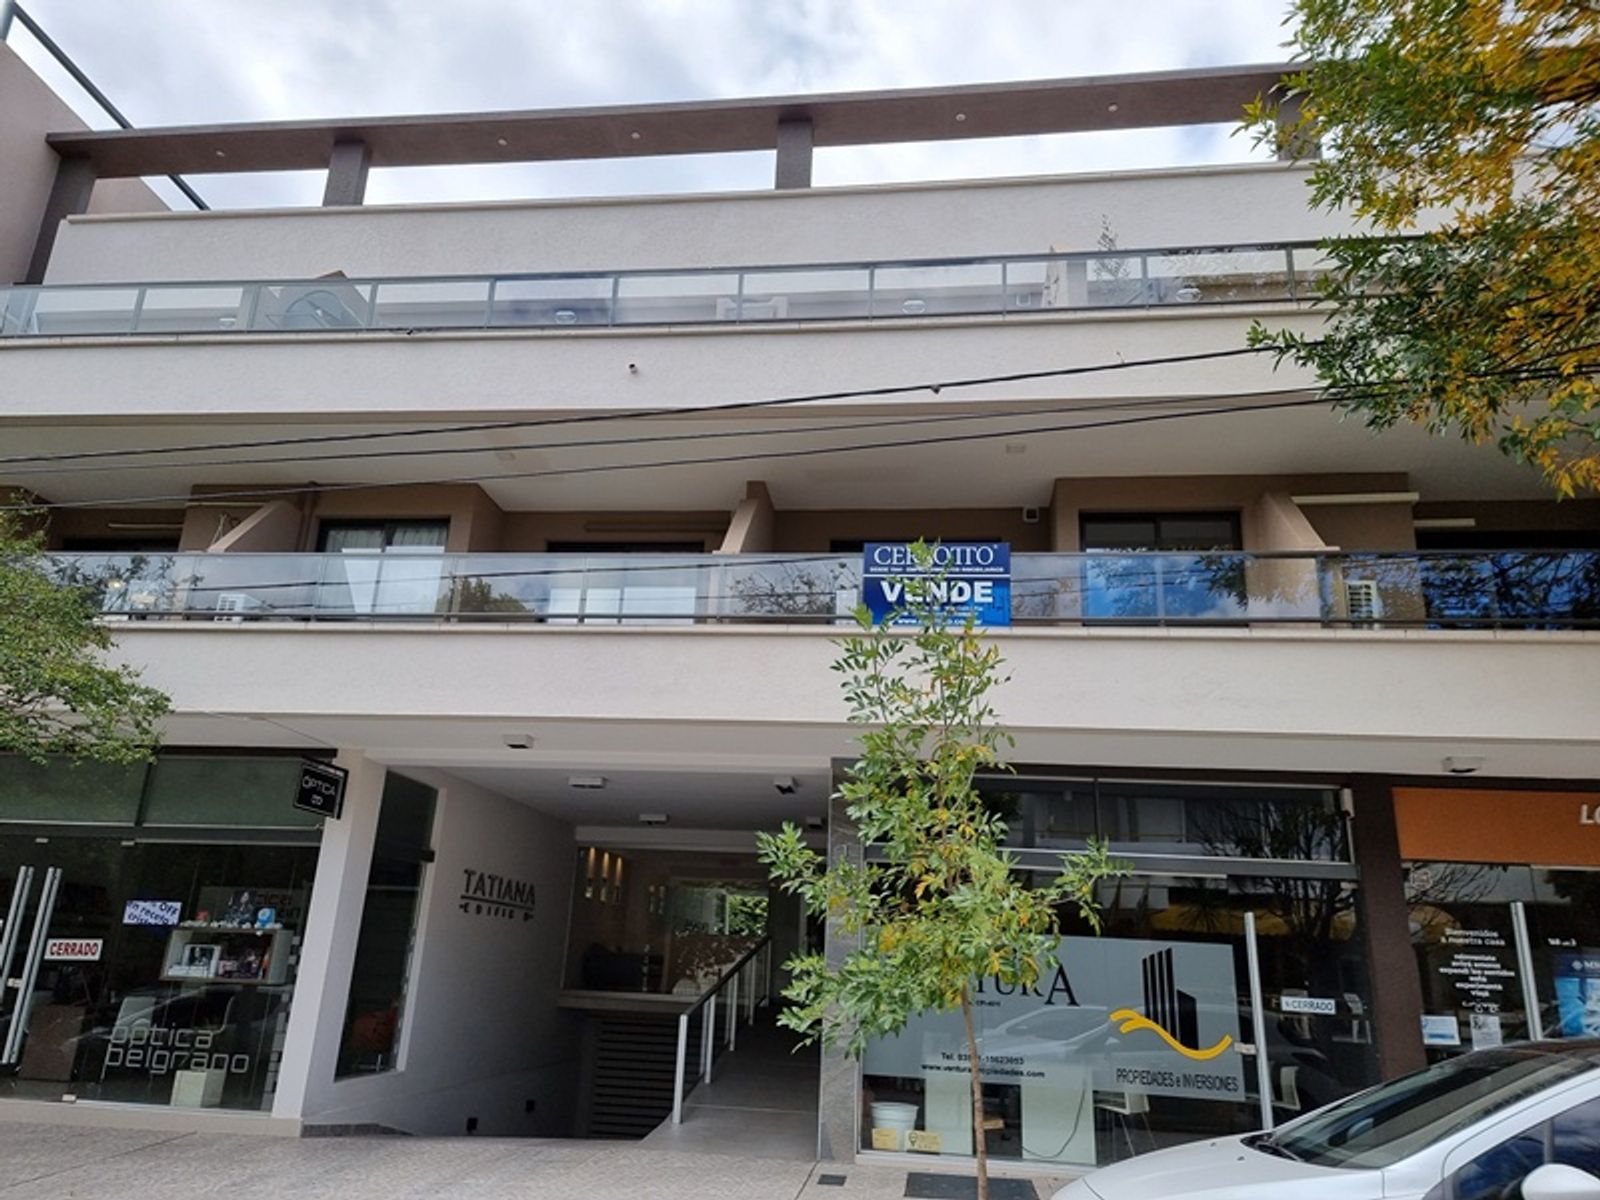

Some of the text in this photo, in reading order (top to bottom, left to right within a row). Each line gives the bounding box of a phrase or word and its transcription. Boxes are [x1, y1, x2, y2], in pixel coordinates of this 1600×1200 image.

[880, 580, 992, 603] VENDE
[464, 869, 535, 905] TATIANA
[50, 942, 99, 956] CERRADO
[1291, 1000, 1334, 1011] CERRADO
[1116, 1068, 1175, 1088] PROPIEDADES
[1182, 1073, 1240, 1092] INVERSIONES
